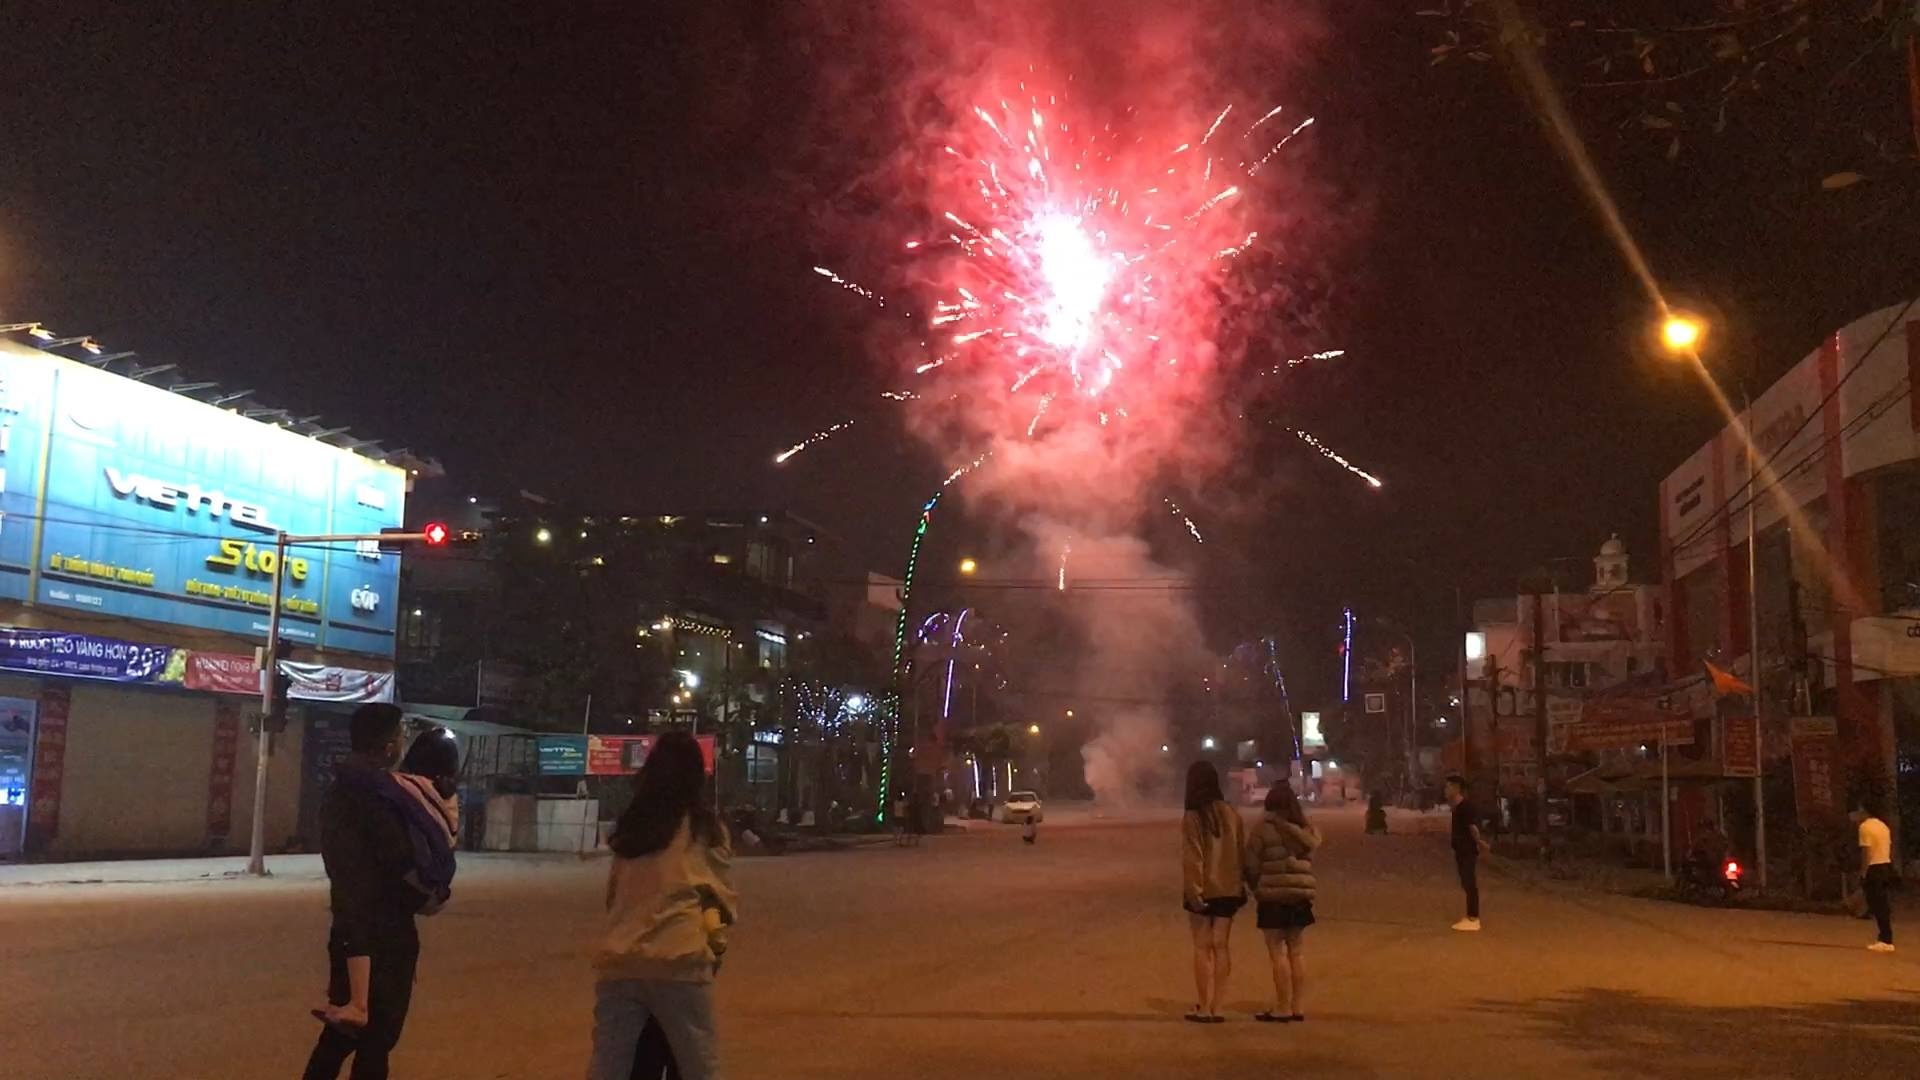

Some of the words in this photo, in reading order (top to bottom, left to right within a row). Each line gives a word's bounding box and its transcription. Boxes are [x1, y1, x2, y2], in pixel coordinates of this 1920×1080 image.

[104, 467, 277, 531] VIETTEL
[205, 538, 309, 580] Store
[76, 636, 103, 658] VÀNG
